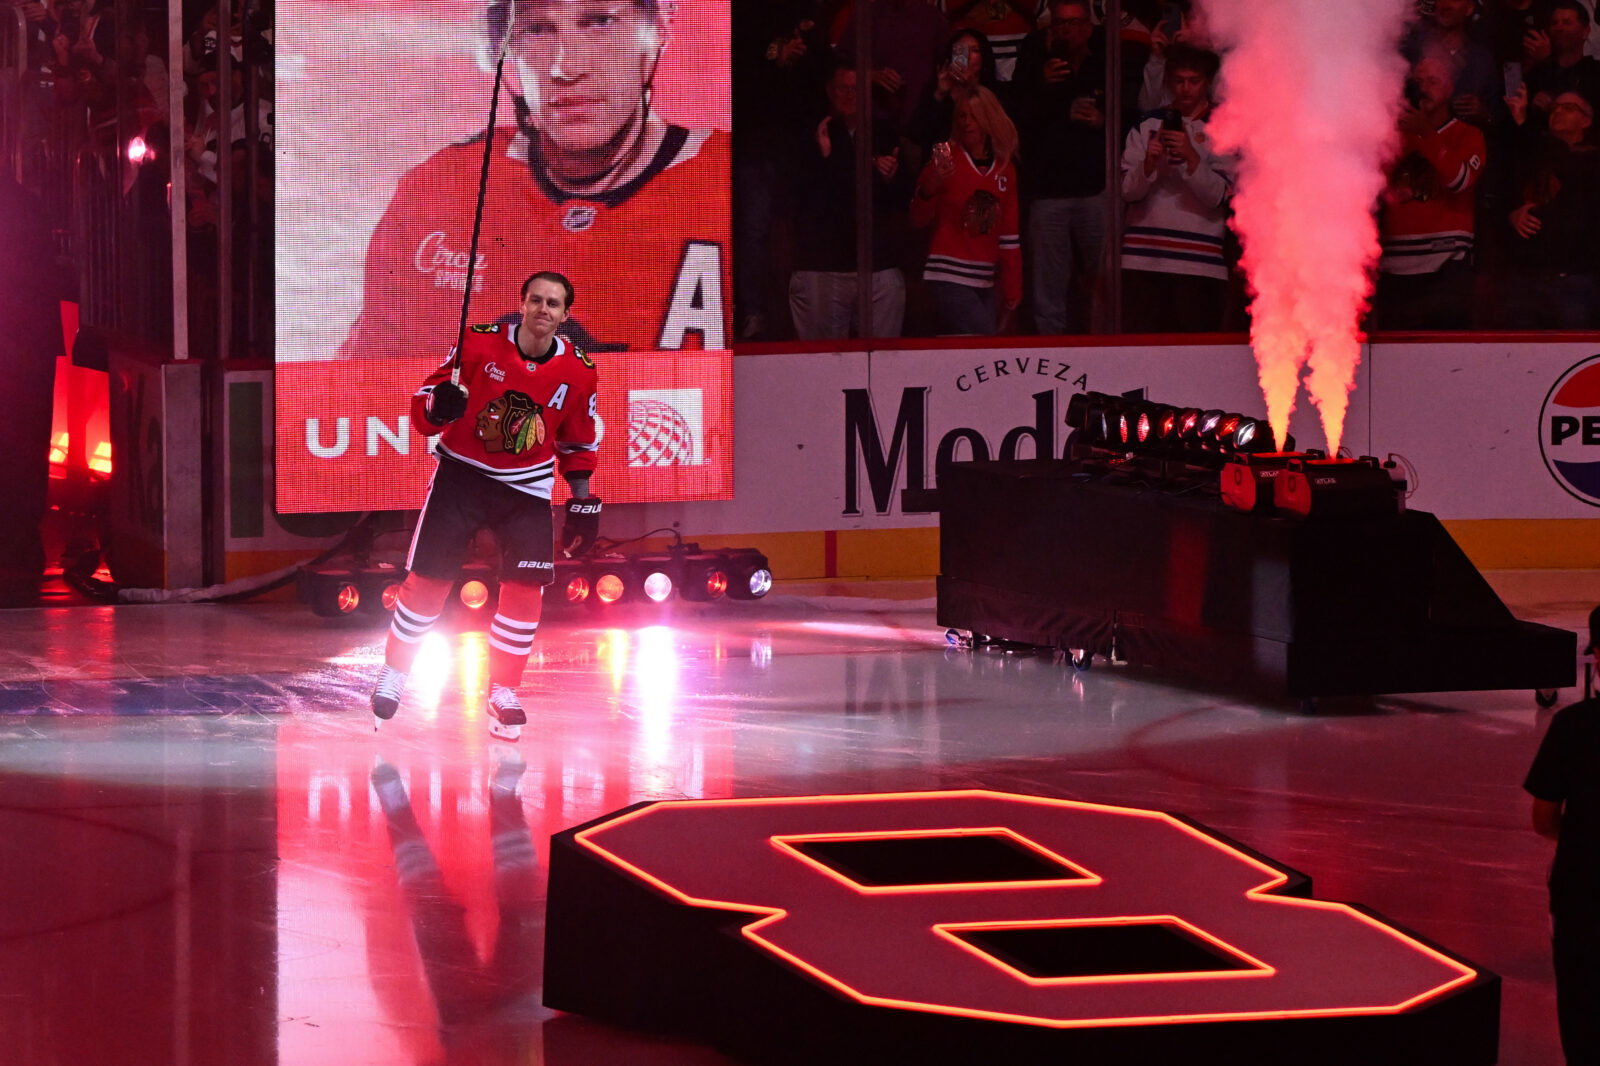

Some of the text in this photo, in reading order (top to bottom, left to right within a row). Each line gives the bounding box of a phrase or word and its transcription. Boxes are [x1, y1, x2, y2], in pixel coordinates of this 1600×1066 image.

[434, 269, 484, 292] SPORS
[658, 241, 726, 350] A
[956, 357, 1089, 392] CERVEZA
[547, 383, 569, 410] A
[842, 386, 1149, 517] Mod
[569, 503, 603, 514] BAU
